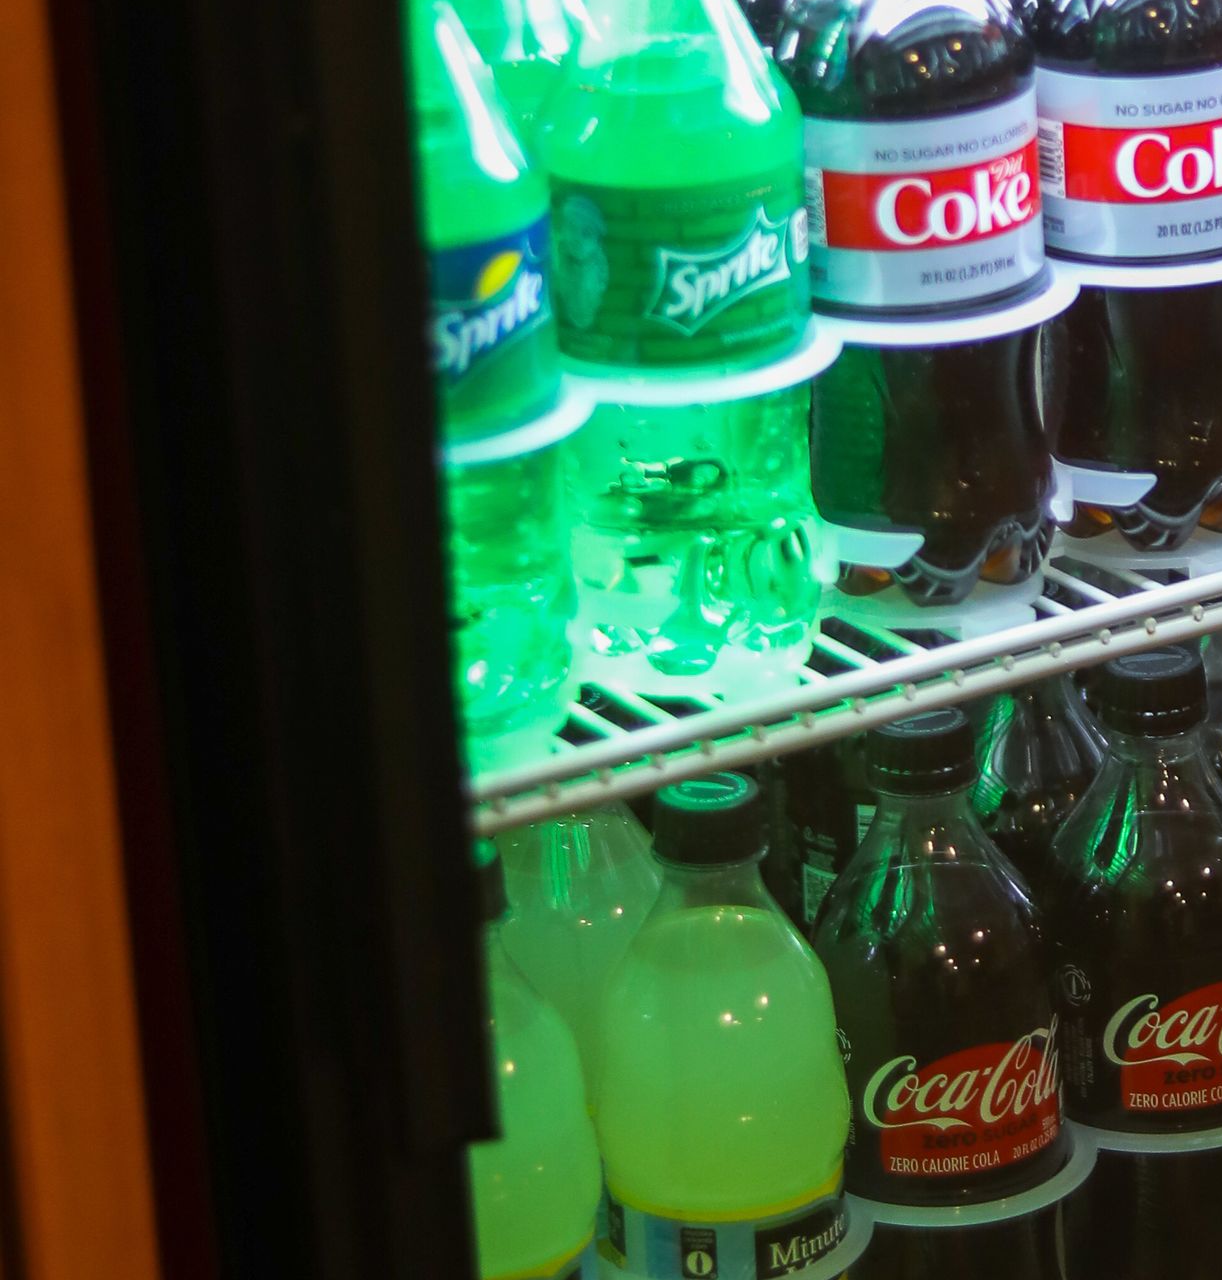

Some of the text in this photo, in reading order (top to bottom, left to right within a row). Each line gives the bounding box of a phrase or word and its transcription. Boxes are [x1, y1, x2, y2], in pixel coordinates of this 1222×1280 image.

[1116, 104, 1138, 117] NO
[1143, 102, 1194, 116] SUGAR
[1196, 96, 1218, 110] NO
[875, 149, 899, 162] NO
[902, 143, 954, 162] SUGAR
[958, 140, 979, 154] NO
[990, 153, 1024, 183] Diet
[875, 168, 1033, 246] Coke
[1157, 225, 1169, 238] 20
[1170, 224, 1180, 236] FL
[1181, 222, 1192, 234] OZ
[666, 228, 779, 319] Sprite
[434, 270, 543, 372] Sprite
[863, 1013, 1060, 1131] Coca-Cola
[1129, 1093, 1159, 1108] ZERO
[1162, 1090, 1207, 1108] CALORIE
[890, 1157, 918, 1172] ZERO
[922, 1156, 969, 1173] CALORIE
[973, 1150, 1000, 1169] COLA
[769, 1214, 845, 1269] Minute
